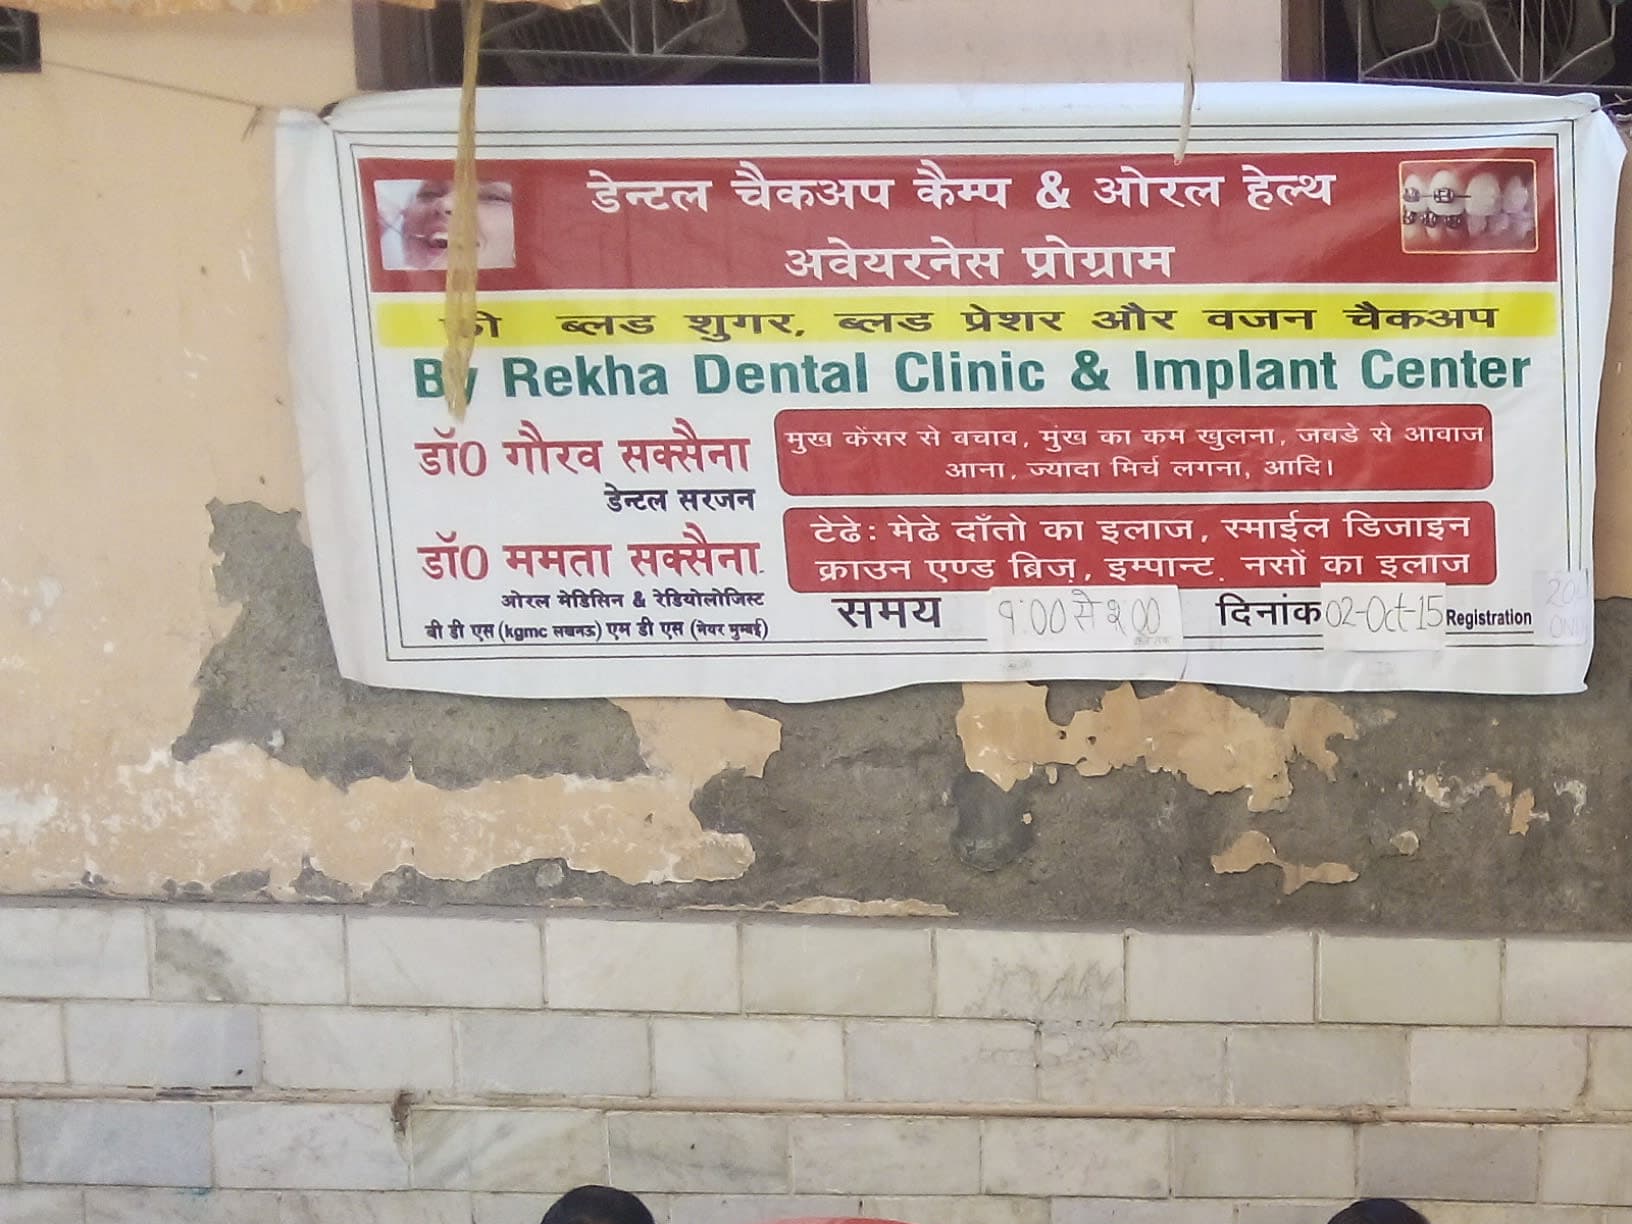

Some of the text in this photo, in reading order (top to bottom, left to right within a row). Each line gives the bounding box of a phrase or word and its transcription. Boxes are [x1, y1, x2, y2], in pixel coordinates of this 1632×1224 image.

[586, 158, 1337, 213] डेन्टल चैकअप कैम्प & ओरल हेल्थ
[785, 236, 1176, 281] अवेयरनेस प्रोग्राम
[556, 315, 655, 336] ब्लड
[684, 312, 806, 342] शुगर,
[834, 312, 932, 333] ब्लड
[961, 303, 1065, 332] प्रेशर
[1093, 303, 1178, 331] और
[1203, 308, 1317, 330] वजन
[1343, 301, 1499, 330] चैकअप
[504, 356, 669, 398] Rekha
[694, 352, 869, 394] Dental
[894, 349, 1045, 393] Clinic
[1071, 350, 1109, 392] &
[1136, 350, 1338, 399] Implant
[1361, 349, 1532, 391] Center
[502, 419, 604, 475] गौरव
[784, 431, 832, 454] मुख
[916, 425, 941, 447] से
[1097, 430, 1131, 447] का
[1142, 429, 1186, 446] कम
[1370, 422, 1393, 443] से
[1404, 426, 1485, 444] आवाज
[945, 462, 1017, 480] आना,
[1027, 461, 1100, 479] ज्यादा
[1111, 456, 1161, 478] मिर्च
[1171, 460, 1252, 480] लगना,
[604, 482, 757, 513] डेन्टल सरजन
[1039, 520, 1085, 542] का
[1096, 519, 1209, 545] इलाज,
[1221, 510, 1331, 540] स्माईल
[1342, 510, 1471, 539] डिजाइन
[502, 544, 613, 578] ममता
[814, 559, 912, 582] क्राउन
[924, 558, 996, 583] एण्ड
[1240, 549, 1308, 577] नसों
[1320, 556, 1364, 576] का
[1375, 554, 1471, 579] इलाज
[501, 591, 550, 609] ओरल
[557, 590, 624, 609] मेडिसिन
[632, 591, 646, 608] &
[831, 596, 942, 629] समय
[1215, 592, 1321, 627] दिनांक
[1446, 608, 1533, 630] Registration
